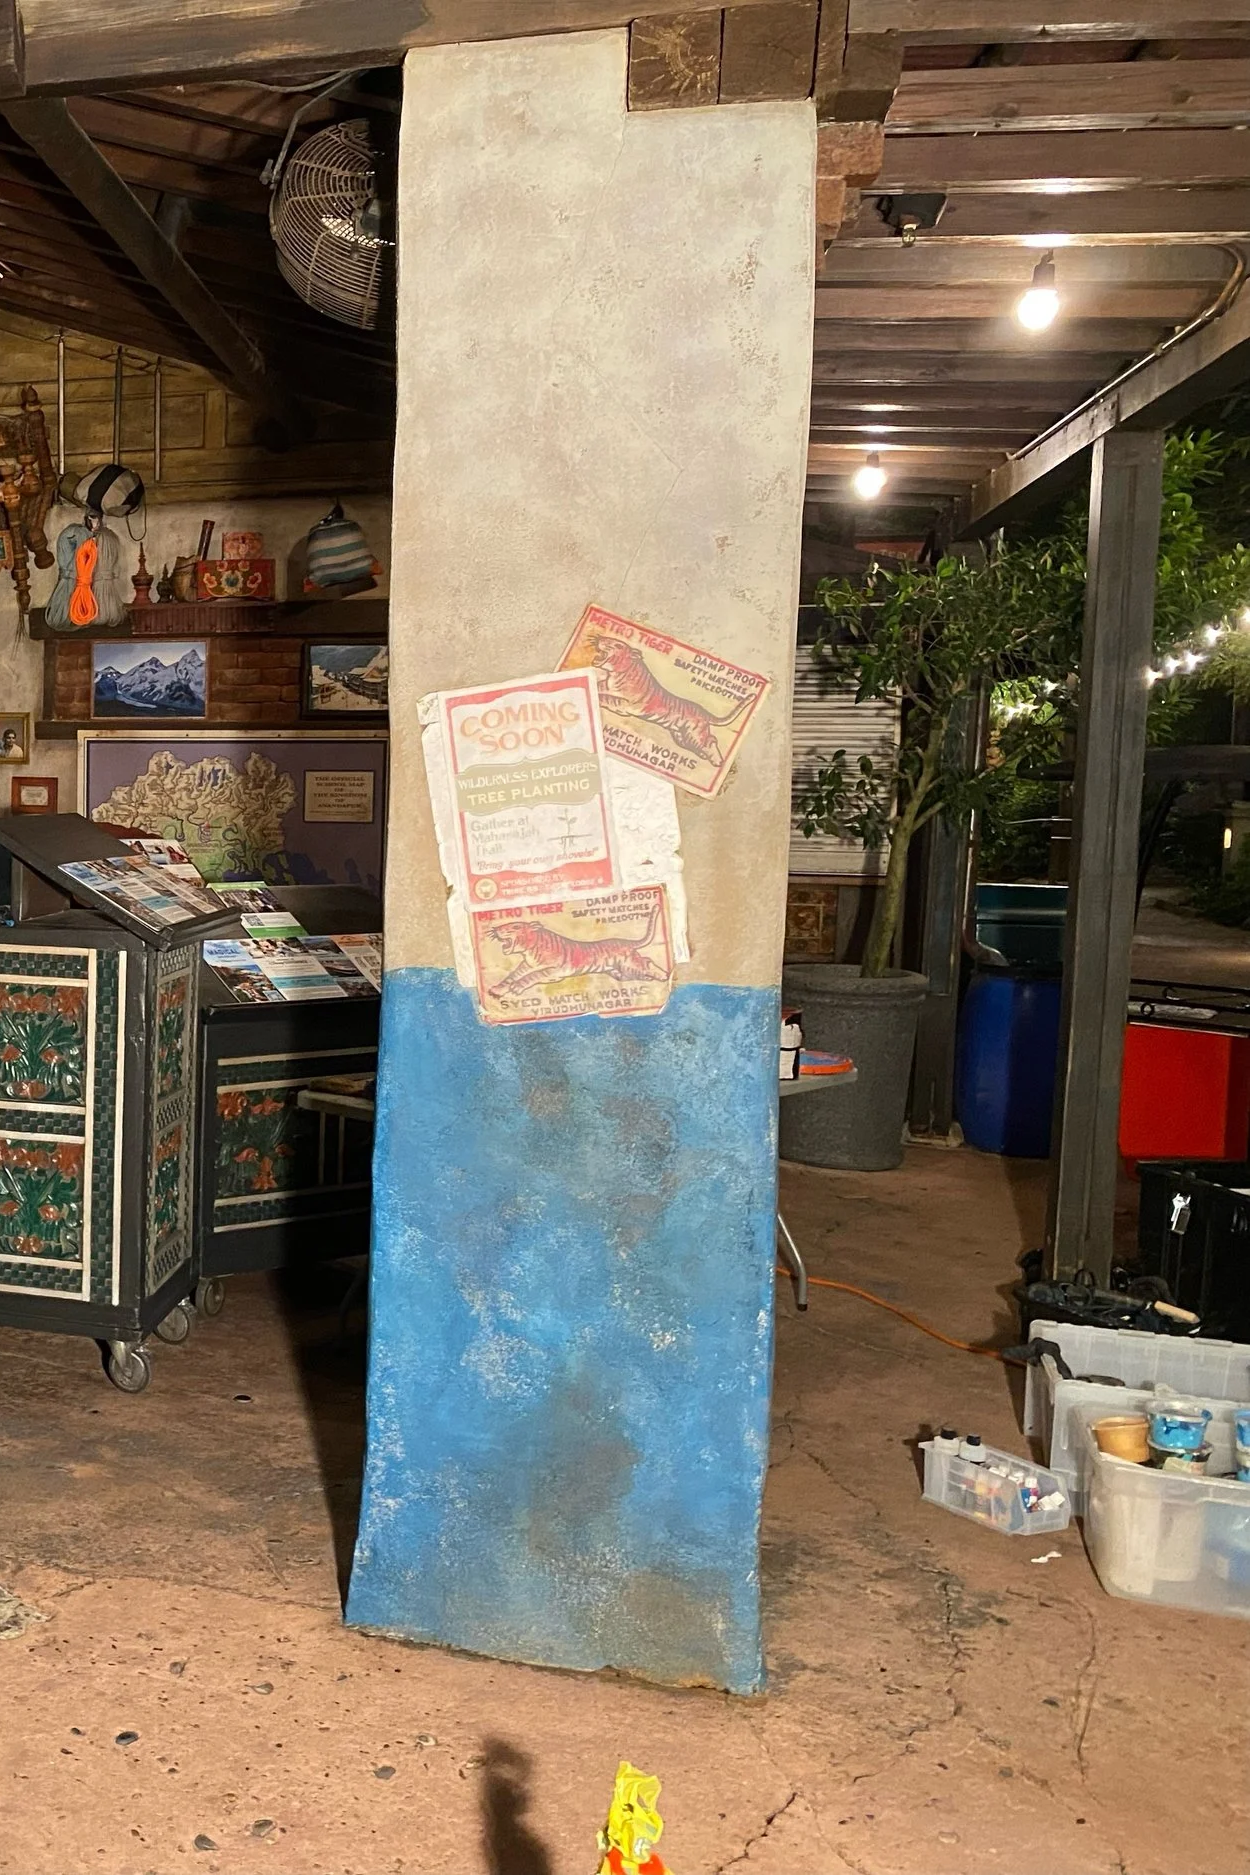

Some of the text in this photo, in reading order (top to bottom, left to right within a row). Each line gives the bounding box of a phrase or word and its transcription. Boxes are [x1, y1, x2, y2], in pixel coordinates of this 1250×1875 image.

[589, 612, 674, 656] METRO TIGER
[673, 657, 748, 695] SAFETY MATCHES
[693, 654, 764, 689] DAMP PROOF
[460, 701, 581, 738] COMING
[478, 723, 565, 757] SOON
[602, 723, 698, 770] MATCH WORKS
[457, 761, 598, 791] WILDERNESS EXPLORERS
[467, 778, 590, 807] TREE PLANTING
[470, 818, 515, 832] Gather
[477, 901, 564, 921] METRO TIGER
[571, 903, 650, 918] SAFETY MATCHES
[586, 891, 659, 907] DAMP PROOF
[500, 985, 649, 1010] SYED MATCH WORKS
